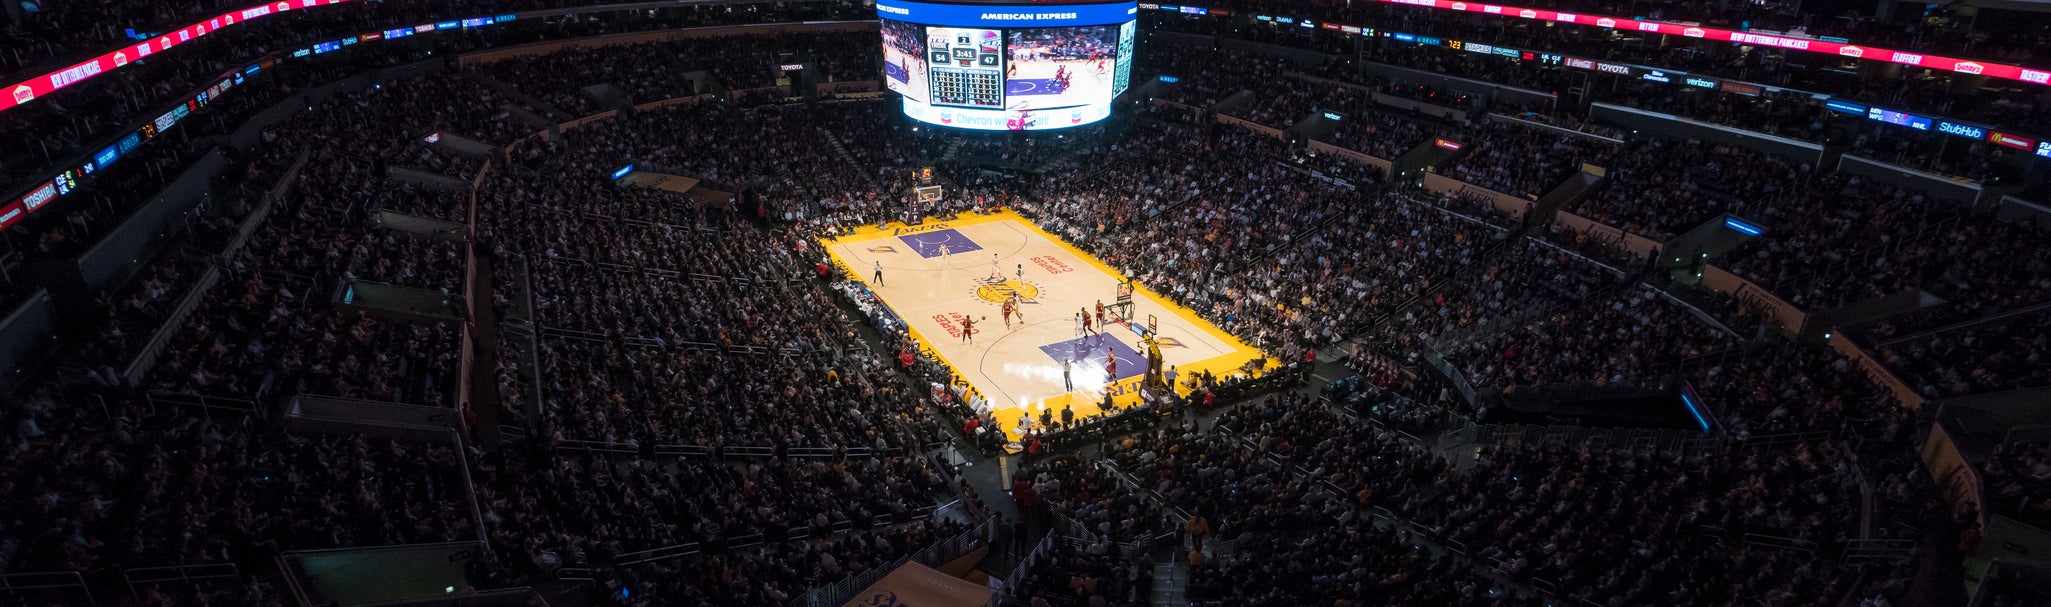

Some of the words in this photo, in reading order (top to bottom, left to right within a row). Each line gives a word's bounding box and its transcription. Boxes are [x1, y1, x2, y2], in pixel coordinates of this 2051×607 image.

[1036, 12, 1077, 20] EXPRESS
[1421, 37, 1440, 45] DELTA
[1744, 34, 1780, 46] BUTTERMILK
[1778, 37, 1810, 50] PANCAKES
[294, 48, 310, 58] verizon
[956, 50, 973, 58] 3:41
[1465, 42, 1492, 54] STAPLES
[936, 54, 946, 62] 54
[984, 56, 994, 64] 47
[1892, 52, 1923, 64] FLUFFIER!
[1596, 62, 1630, 75] TOYOTA
[1956, 64, 1981, 72] Denny's
[1686, 78, 1715, 88] verizon
[956, 114, 992, 126] Chevron
[1324, 112, 1342, 121] verizon
[1912, 122, 1926, 130] NHL
[1939, 122, 1982, 138] StubHub
[56, 174, 66, 186] CLE
[24, 182, 56, 210] TOSHIBA
[894, 222, 949, 236] LAKERS
[1030, 256, 1062, 275] STAPLES
[1043, 254, 1074, 272] Center
[932, 314, 962, 338] STAPLES
[948, 311, 980, 336] Ceter
